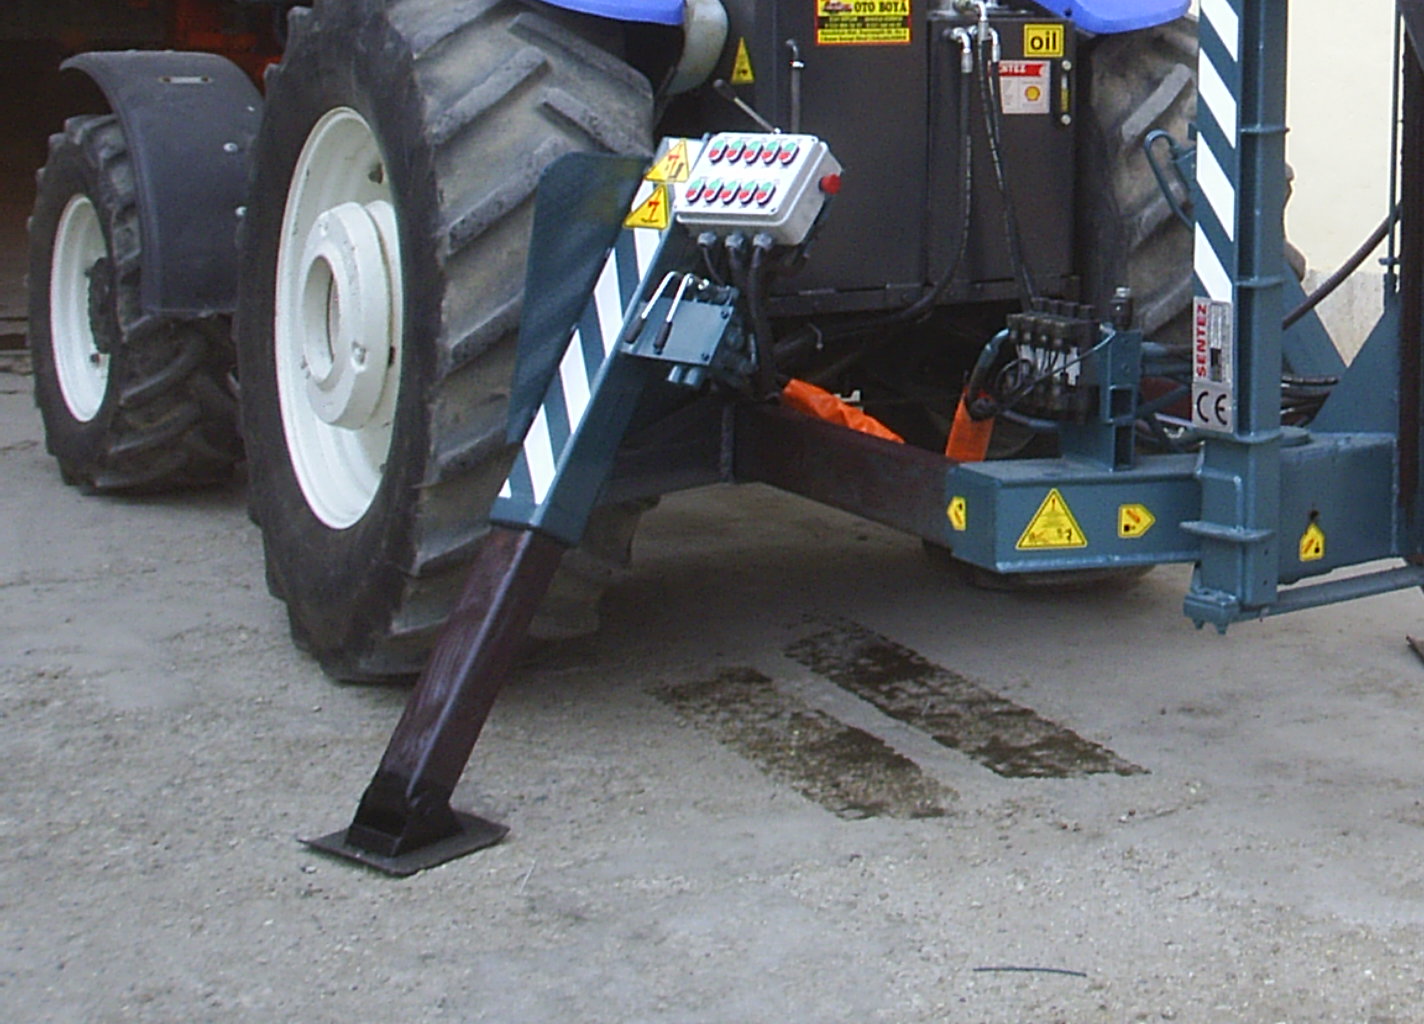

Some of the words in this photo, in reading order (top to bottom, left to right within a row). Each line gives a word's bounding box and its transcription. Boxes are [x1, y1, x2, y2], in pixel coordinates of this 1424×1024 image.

[854, 2, 876, 13] OTO
[879, 2, 907, 13] BOYA
[1030, 31, 1056, 50] oil
[1196, 304, 1207, 378] SENTEZ
[1196, 391, 1228, 426] CE
